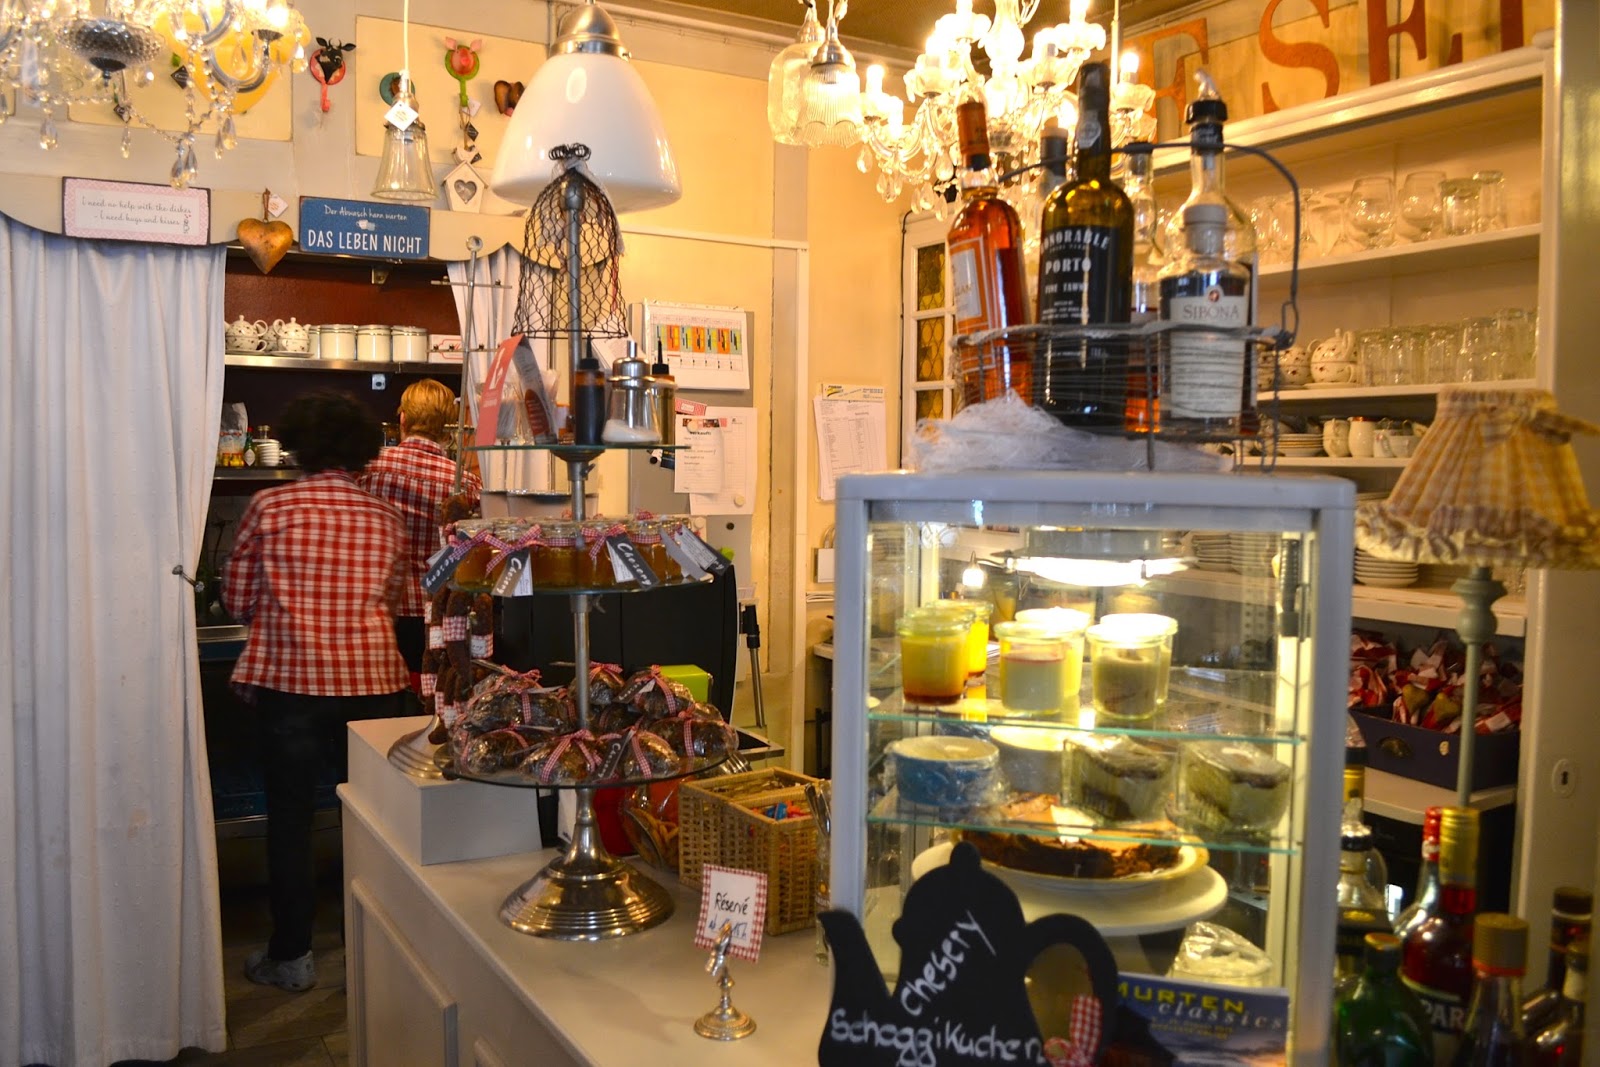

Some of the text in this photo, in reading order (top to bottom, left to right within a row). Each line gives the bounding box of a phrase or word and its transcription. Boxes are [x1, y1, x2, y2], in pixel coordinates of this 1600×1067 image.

[88, 196, 105, 207] need
[119, 199, 135, 211] help
[136, 201, 153, 211] with
[155, 202, 168, 212] the
[169, 203, 192, 214] dishes
[324, 204, 337, 215] Der
[339, 206, 368, 218] Abwasch
[385, 211, 408, 221] warten
[105, 211, 123, 221] need
[125, 213, 142, 225] hugs
[144, 214, 158, 224] and
[159, 215, 180, 226] kisses
[308, 229, 422, 254] DAS LEBEN NICHT
[1045, 257, 1091, 275] PORTO
[1158, 1001, 1283, 1030] classics
